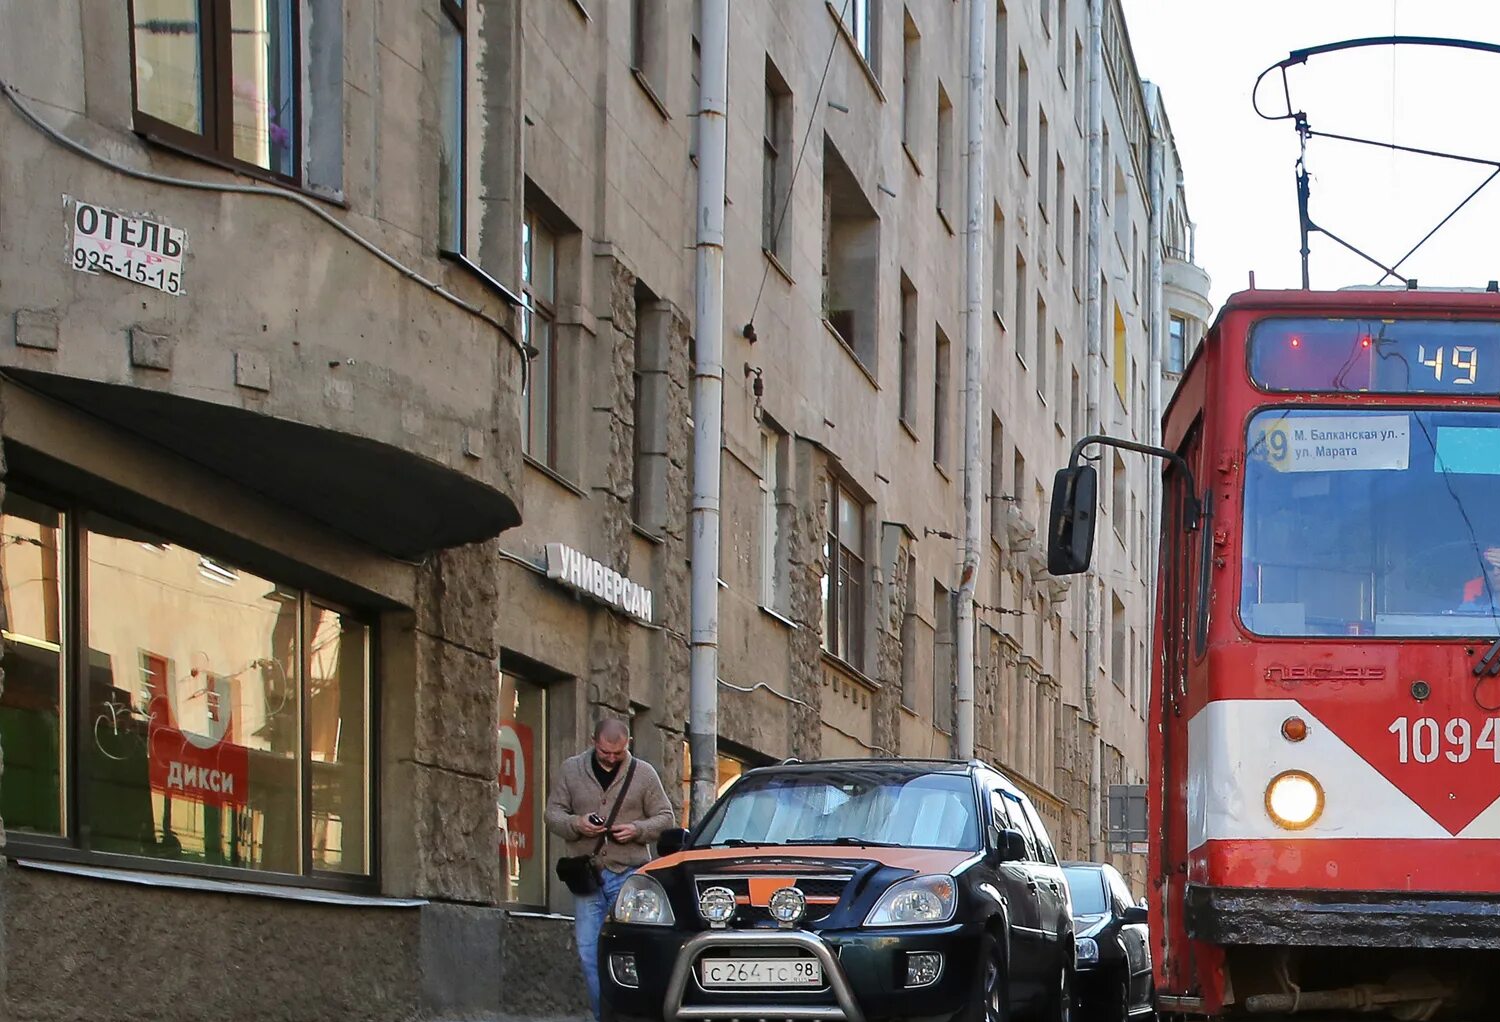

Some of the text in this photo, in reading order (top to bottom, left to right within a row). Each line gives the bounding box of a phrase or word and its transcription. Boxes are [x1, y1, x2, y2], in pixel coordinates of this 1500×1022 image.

[77, 205, 181, 257] ОТЕЛЬ
[75, 248, 179, 293] 925-15-15
[1418, 344, 1477, 385] 49
[1294, 430, 1307, 441] М.
[1311, 429, 1377, 441] Балканская
[1380, 430, 1398, 442] ул.
[1295, 447, 1357, 460] ул. Марата
[559, 543, 652, 623] УНИВЕРСАМ
[167, 761, 233, 794] ДИКСИ
